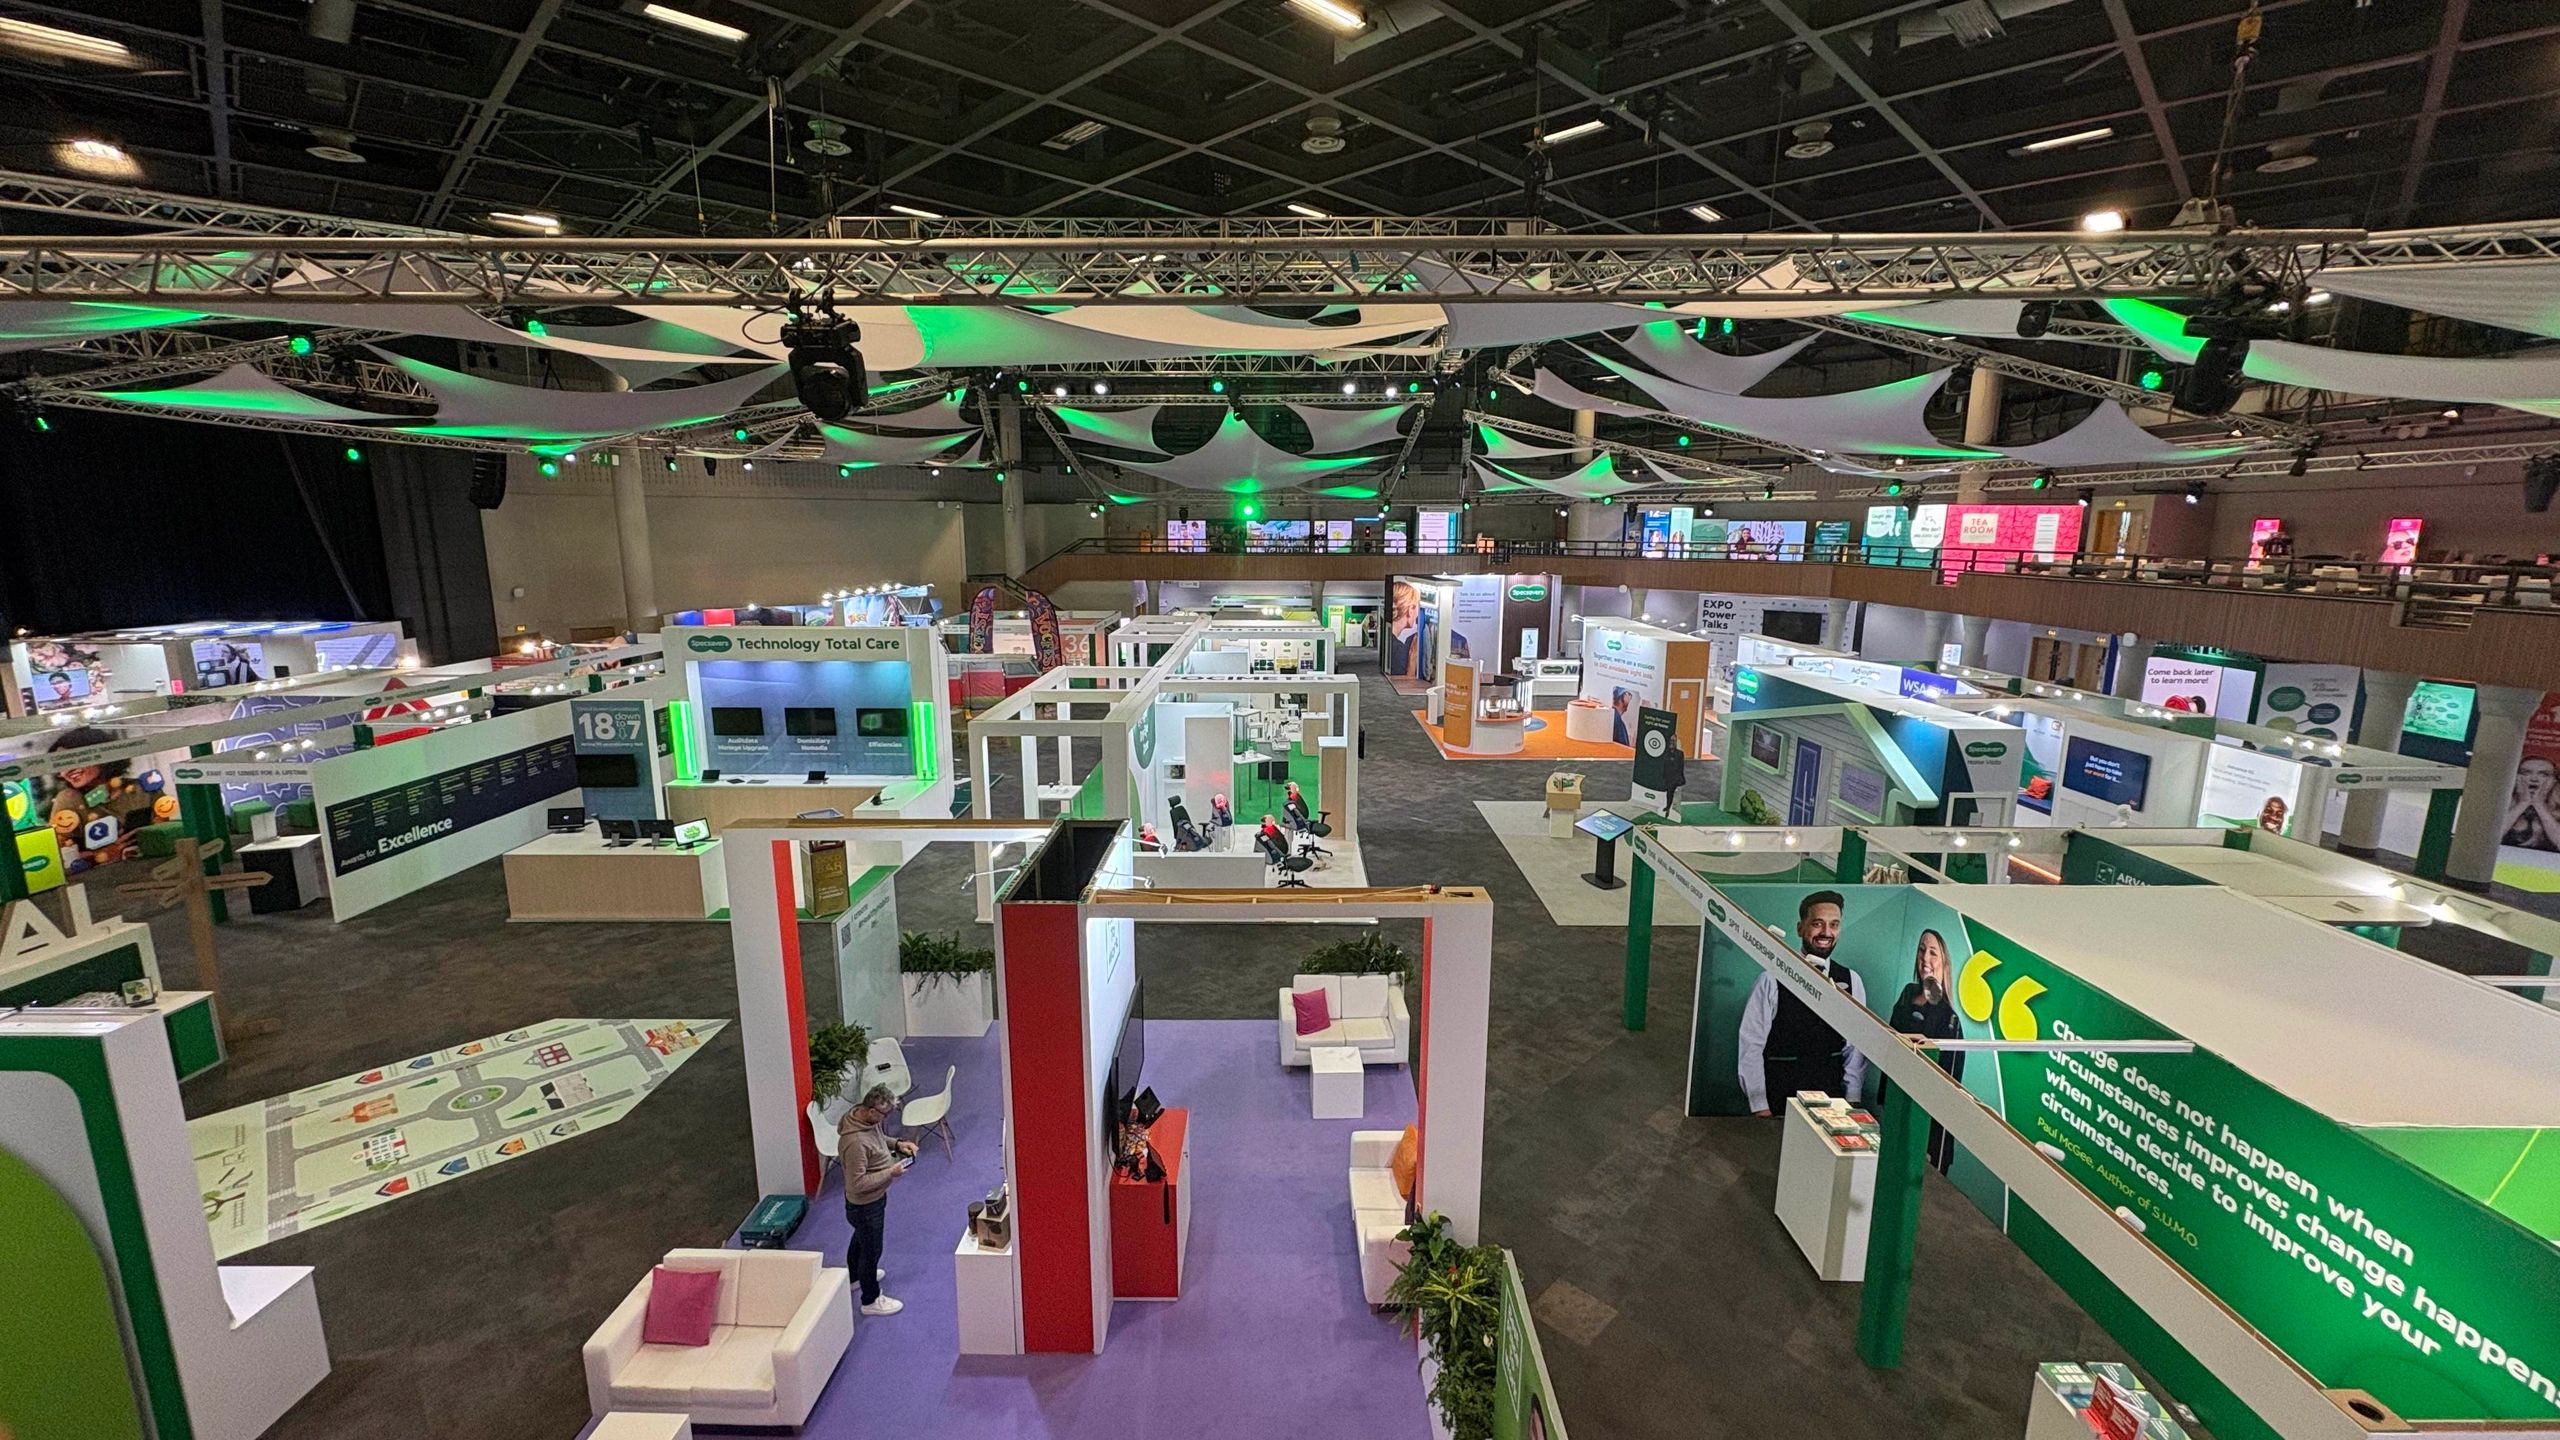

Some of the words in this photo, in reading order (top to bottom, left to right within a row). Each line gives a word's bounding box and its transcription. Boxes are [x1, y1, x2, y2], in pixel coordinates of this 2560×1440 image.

[1972, 518, 1989, 526] TEA
[1964, 526, 1995, 535] ROOM
[1512, 588, 1545, 597] Specsavers
[1703, 600, 1733, 610] EXPO
[1702, 609, 1736, 620] Power
[1702, 620, 1728, 629] Talks
[690, 639, 730, 648] Specsavers
[737, 637, 820, 652] Technology
[825, 637, 861, 650] Total
[865, 638, 900, 650] Care
[1065, 634, 1089, 653] 36
[2148, 668, 2170, 676] Come
[2173, 668, 2191, 677] back
[2194, 669, 2214, 677] later
[2184, 677, 2209, 685] more!
[615, 711, 641, 721] down
[578, 712, 616, 740] 18
[616, 720, 627, 728] to
[626, 721, 641, 740] 7
[340, 854, 366, 868] Awards
[377, 818, 453, 854] Excellence
[2117, 872, 2151, 886] ARVA
[1742, 929, 1776, 961] LEADERSHIP
[1775, 959, 1823, 1001] DEVELOPMENT
[2041, 1092, 2174, 1200] circumstances.
[2053, 1019, 2119, 1073] Chge
[2123, 1066, 2171, 1107] does
[2176, 1099, 2216, 1136] not
[2221, 1123, 2319, 1203] happen
[2327, 1194, 2414, 1266] when
[2048, 1050, 2179, 1142] circumstances
[2185, 1131, 2290, 1220] improve;
[2296, 1212, 2406, 1297] change
[2037, 1116, 2058, 1138] Paul
[2059, 1135, 2096, 1169] McGee,
[2097, 1164, 2135, 1198] Author
[2137, 1195, 2150, 1211] of
[2152, 1207, 2199, 1250] S.U.M.O.
[2045, 1067, 2092, 1111] when
[2097, 1104, 2132, 1139] you
[2136, 1130, 2206, 1191] decide
[2212, 1184, 2238, 1213] to
[2244, 1202, 2355, 1298] improve
[2362, 1292, 2442, 1356] your
